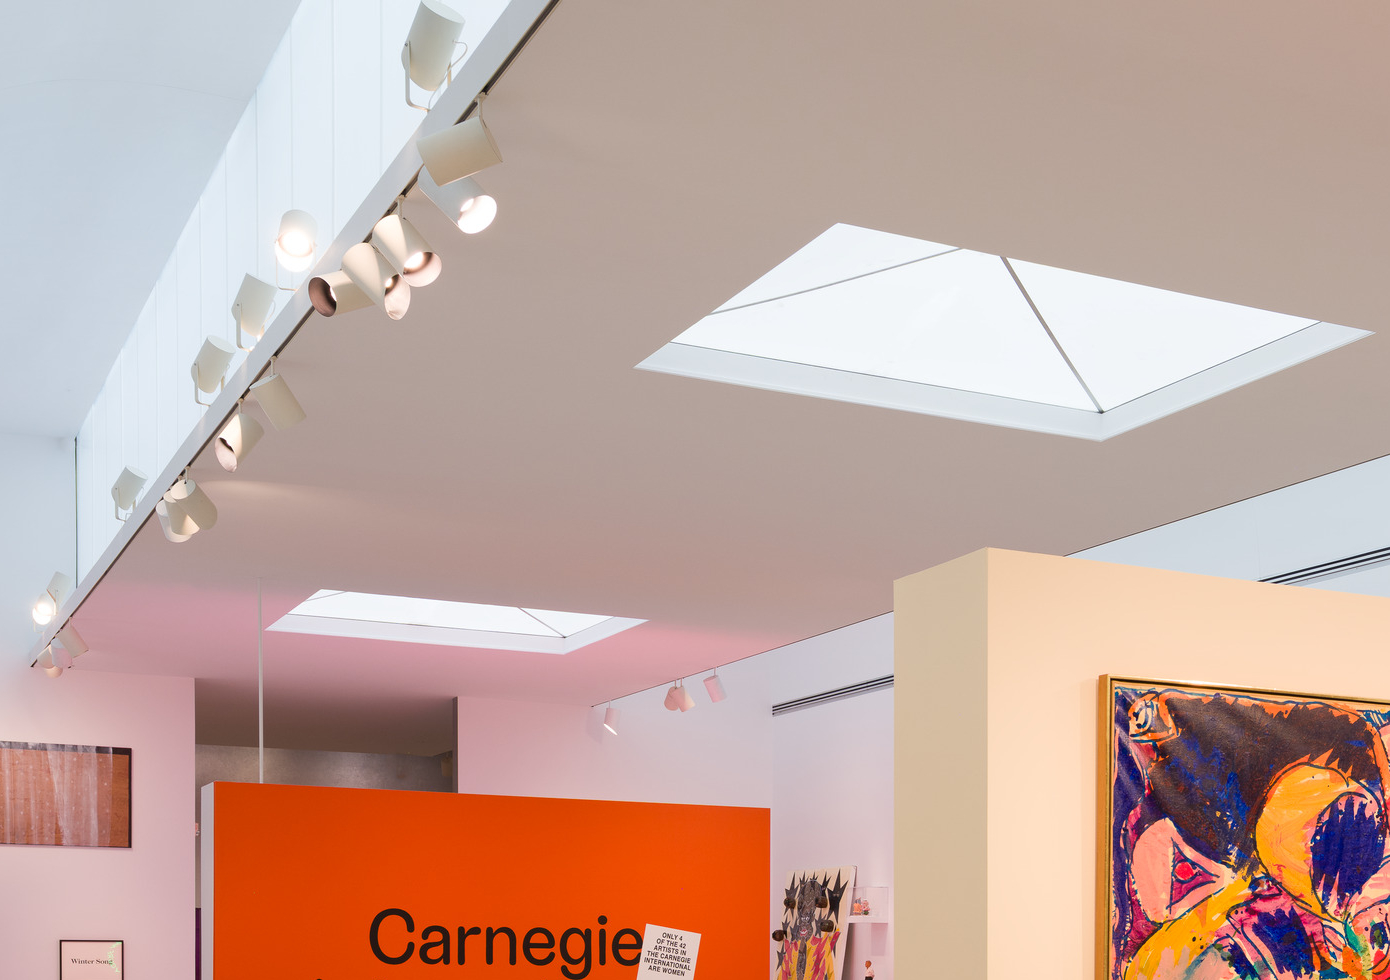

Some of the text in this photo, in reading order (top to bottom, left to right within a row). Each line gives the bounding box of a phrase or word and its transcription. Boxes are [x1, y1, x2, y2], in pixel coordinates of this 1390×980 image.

[662, 932, 678, 941] ONLY
[369, 908, 643, 980] Carnegie
[653, 945, 679, 954] ARTISTS
[660, 953, 691, 963] CARNEGIE
[644, 957, 691, 971] INTERNATIONAL
[662, 967, 685, 976] WOMEN
